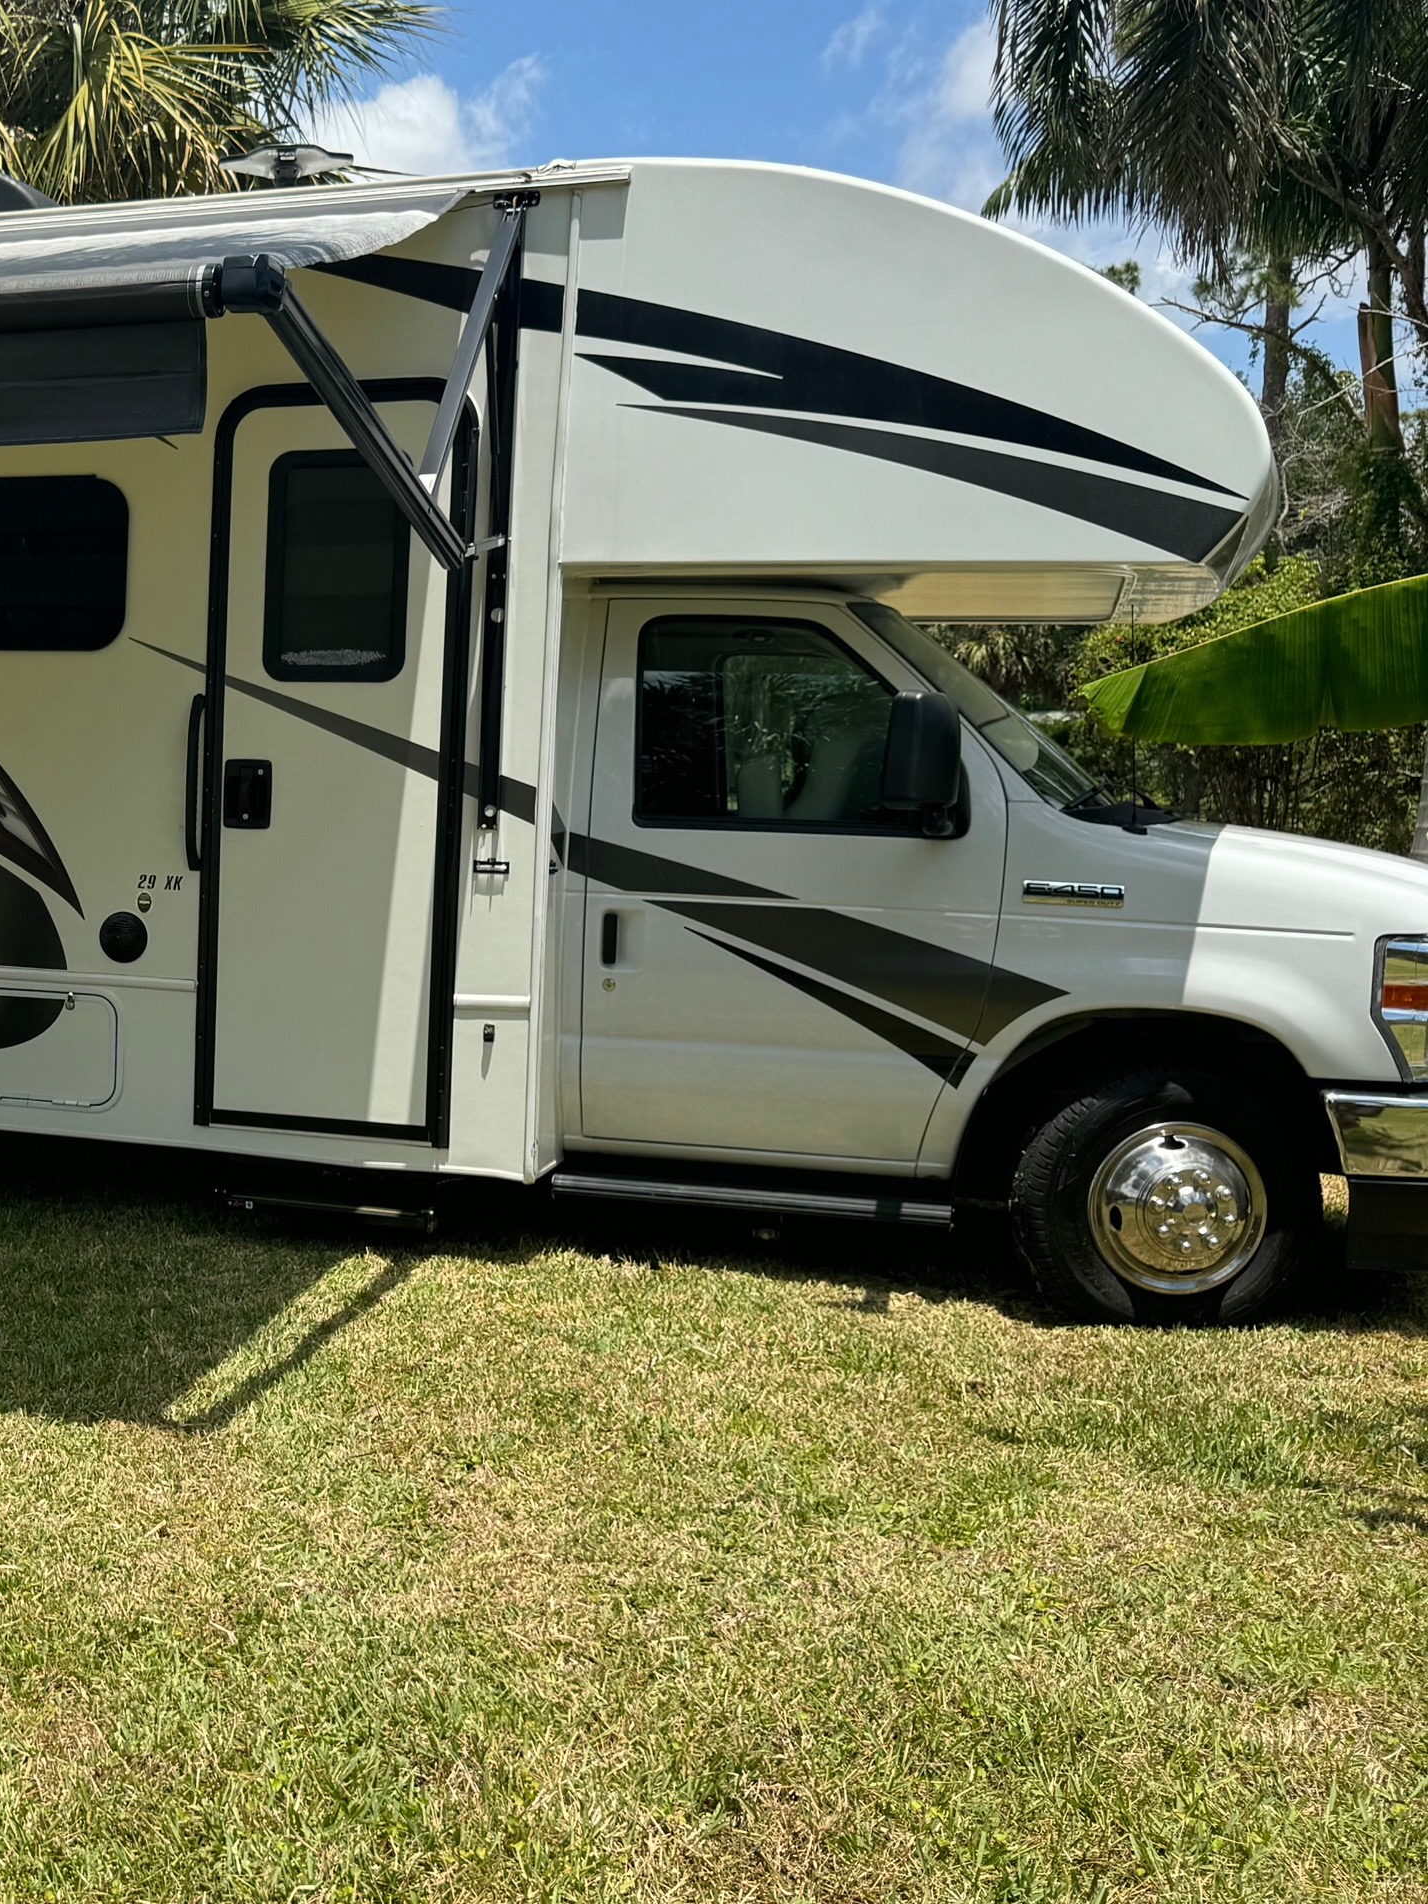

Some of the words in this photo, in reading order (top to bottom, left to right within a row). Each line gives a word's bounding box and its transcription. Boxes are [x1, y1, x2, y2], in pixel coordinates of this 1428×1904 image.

[137, 874, 157, 890] 29
[164, 875, 184, 891] XK
[1025, 882, 1124, 899] E-450
